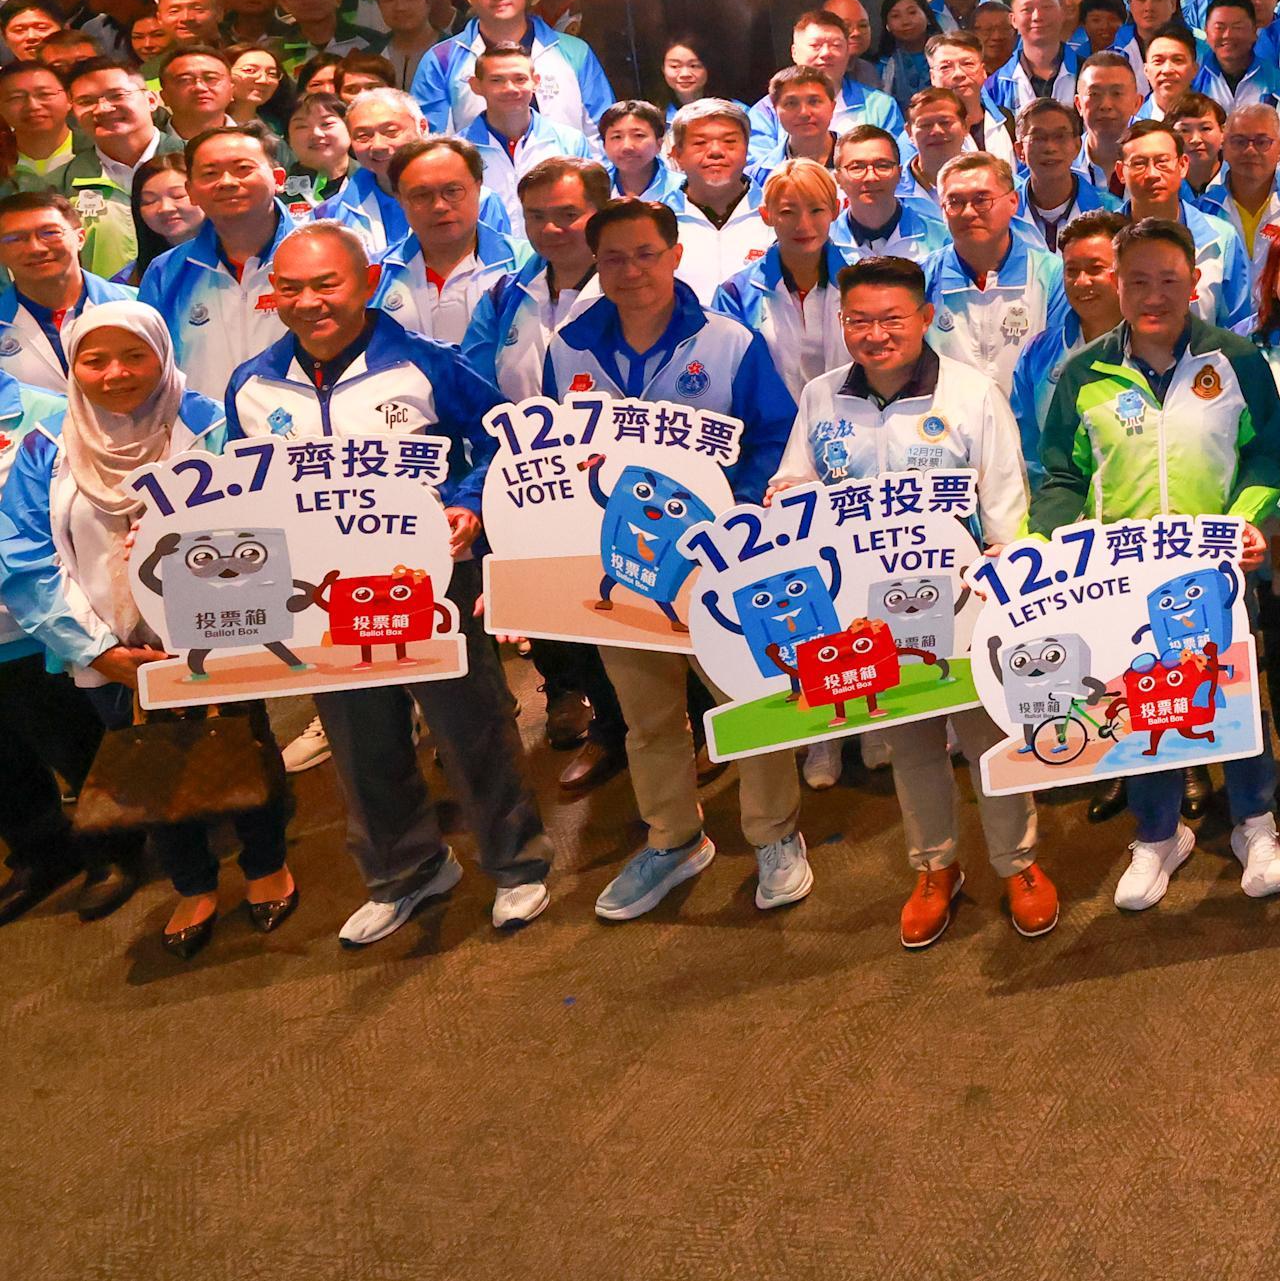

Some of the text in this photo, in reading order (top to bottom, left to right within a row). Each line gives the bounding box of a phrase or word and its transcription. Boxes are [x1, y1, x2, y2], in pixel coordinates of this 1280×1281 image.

[490, 400, 737, 461] 12.7 齊投票
[908, 447, 943, 457] 12月7日
[133, 439, 443, 517] 12.7 齊投票
[502, 455, 566, 488] LET'S
[296, 488, 375, 513] LET'S
[507, 480, 575, 508] VOTE
[335, 514, 417, 536] VOTE
[686, 475, 972, 574] 12.7 齊投票
[854, 526, 925, 555] LET'S
[610, 553, 658, 588] 投票箱
[880, 549, 955, 573] VOTE
[974, 522, 1240, 604] 12.7 齊投票
[616, 569, 648, 590] Ballot Box
[1008, 576, 1132, 628] LET'S VOTE
[196, 609, 267, 630] 投票箱
[353, 613, 410, 631] 投票箱
[204, 626, 259, 639] Ballot Box
[360, 628, 403, 637] Ballot Box
[824, 665, 877, 689] 投票箱
[832, 681, 872, 696] Ballot Box
[1018, 701, 1060, 714] 投票箱
[1141, 697, 1188, 718] 投票箱
[1148, 714, 1184, 726] Ballot Box
